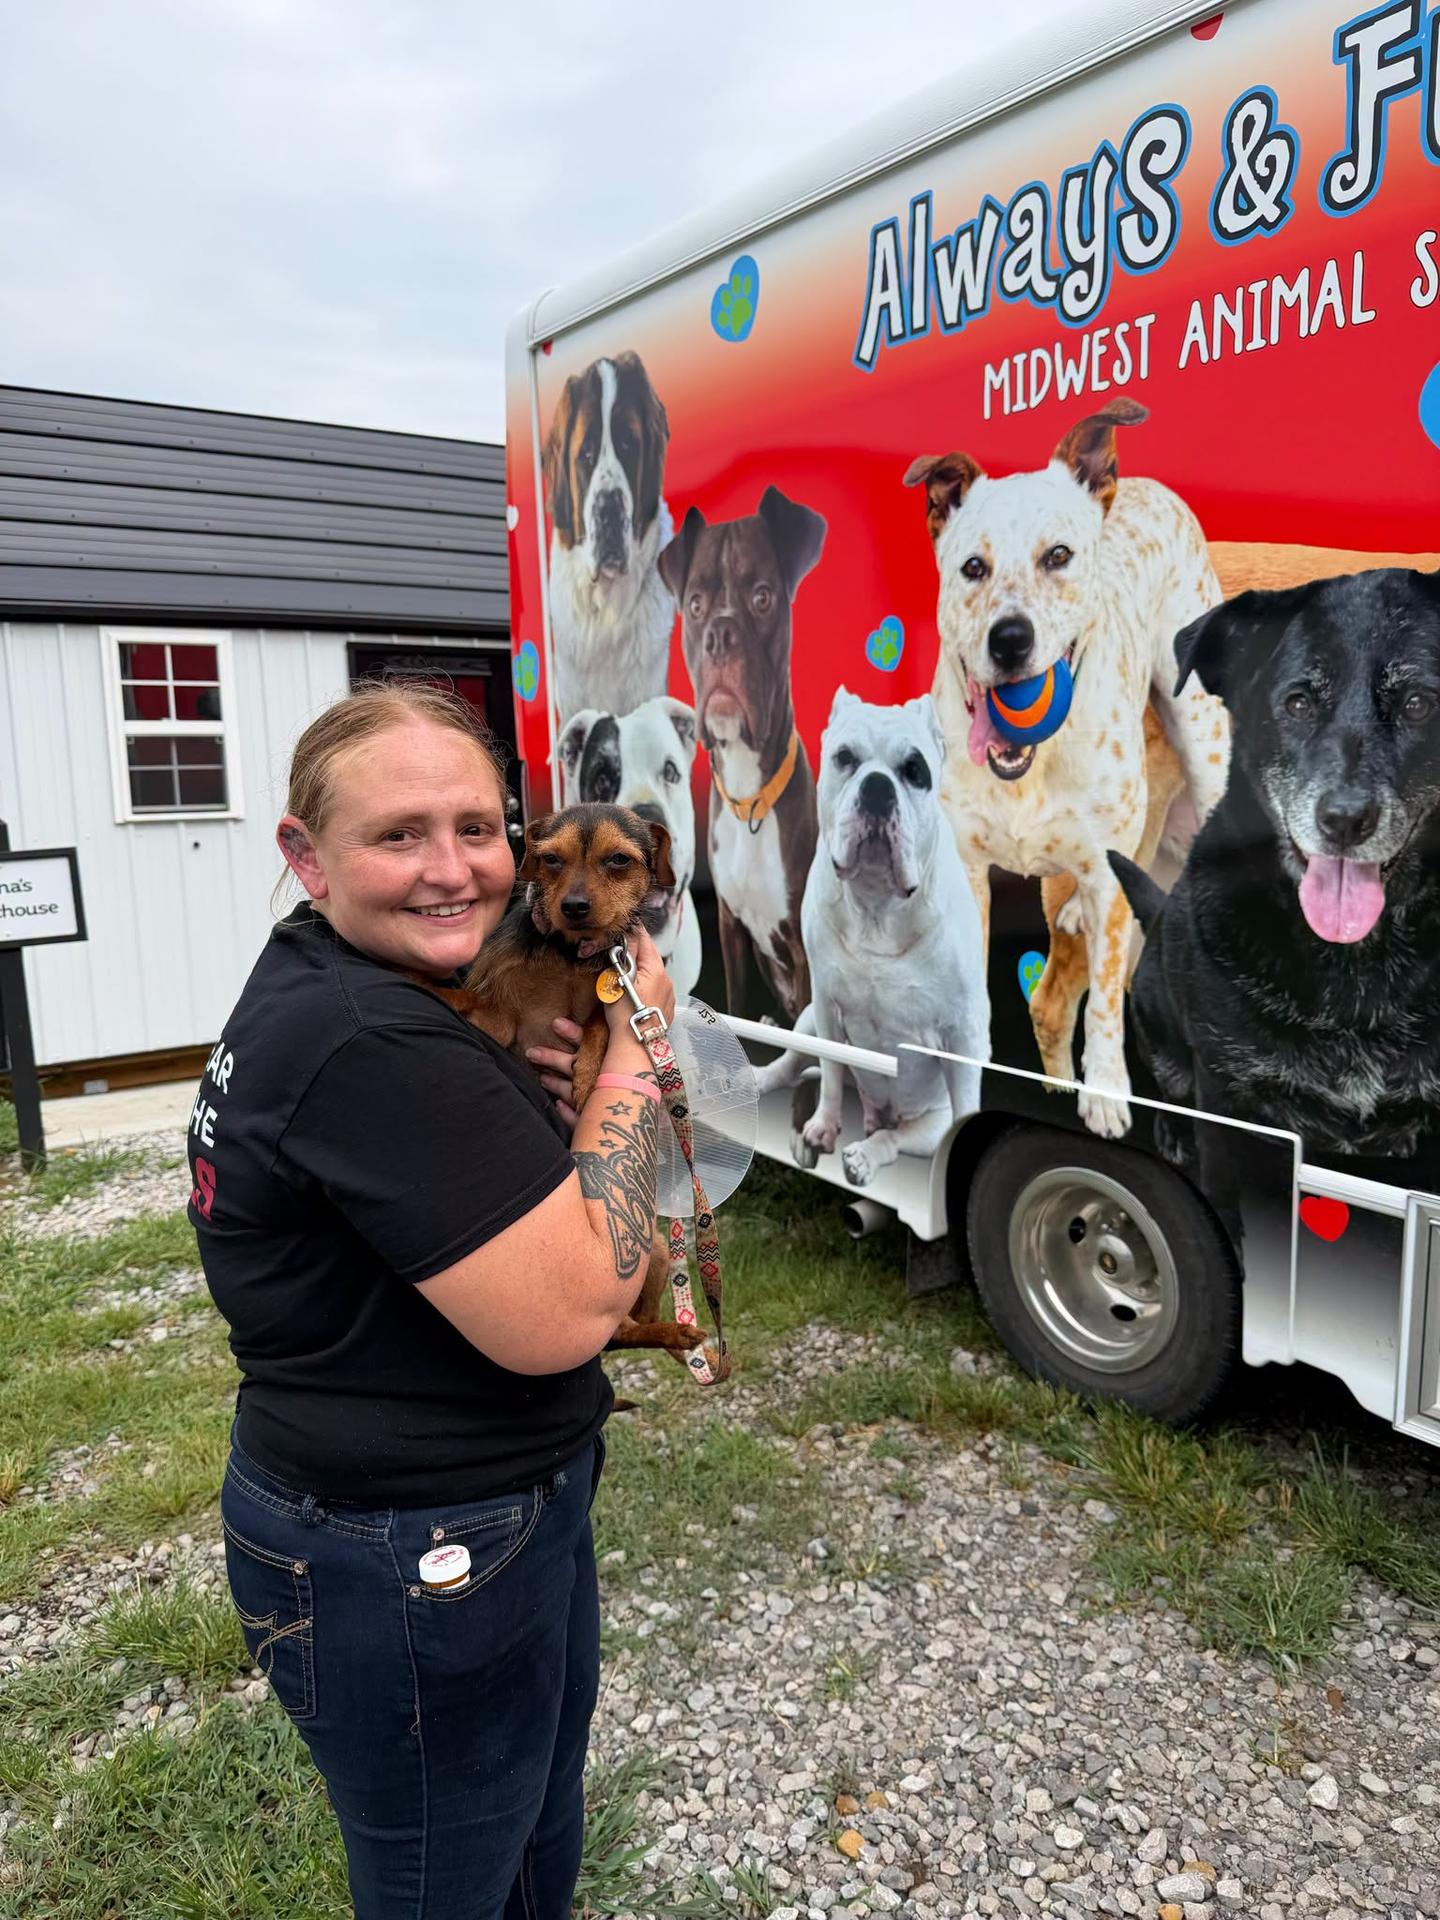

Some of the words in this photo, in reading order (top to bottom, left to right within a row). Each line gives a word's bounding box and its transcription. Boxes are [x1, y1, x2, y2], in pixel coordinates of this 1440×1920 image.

[1215, 93, 1295, 236] &
[1323, 2, 1440, 210] F
[983, 312, 1156, 420] MIDWEST
[1178, 249, 1376, 369] ANIMAL
[206, 1042, 234, 1095] AR
